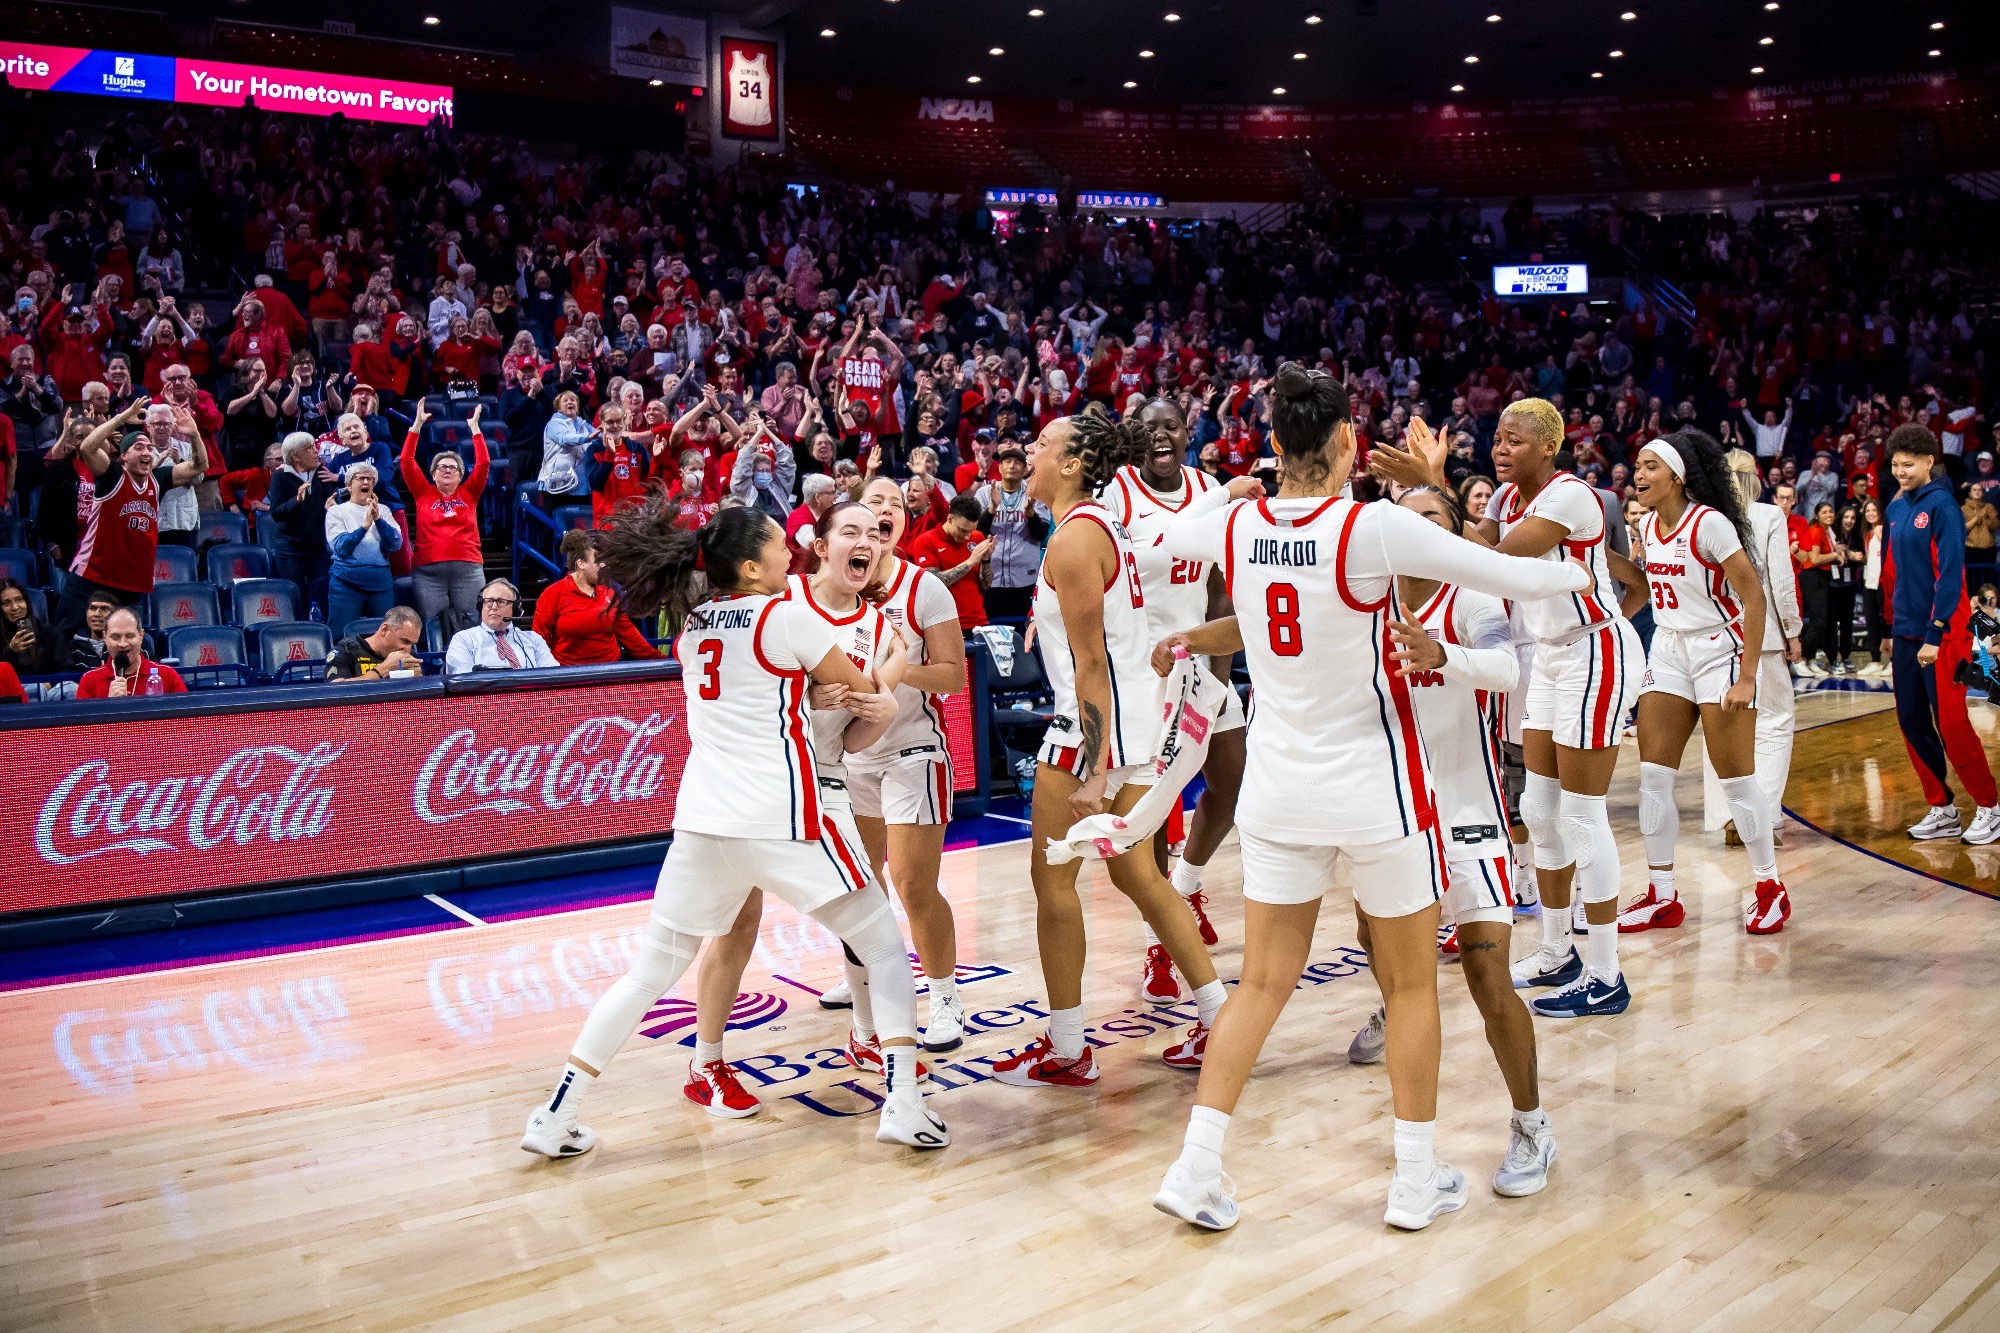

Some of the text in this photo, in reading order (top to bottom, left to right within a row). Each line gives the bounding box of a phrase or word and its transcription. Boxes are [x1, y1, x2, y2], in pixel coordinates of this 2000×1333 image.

[102, 73, 146, 88] Hughes
[190, 69, 244, 94] Your
[250, 76, 373, 108] Hometown
[739, 80, 762, 100] 34
[917, 97, 995, 123] NCAA
[1518, 266, 1569, 275] WILDCATS
[845, 359, 881, 377] BEAR
[845, 373, 881, 389] DOWN
[128, 515, 149, 531] 03
[1249, 538, 1317, 567] JURADO
[1170, 557, 1202, 584] 20
[1651, 581, 1679, 610] 33
[1266, 582, 1303, 657] 8
[698, 639, 723, 700] 3
[411, 712, 675, 824] Coca-Cola
[34, 741, 347, 865] Coca-Cola
